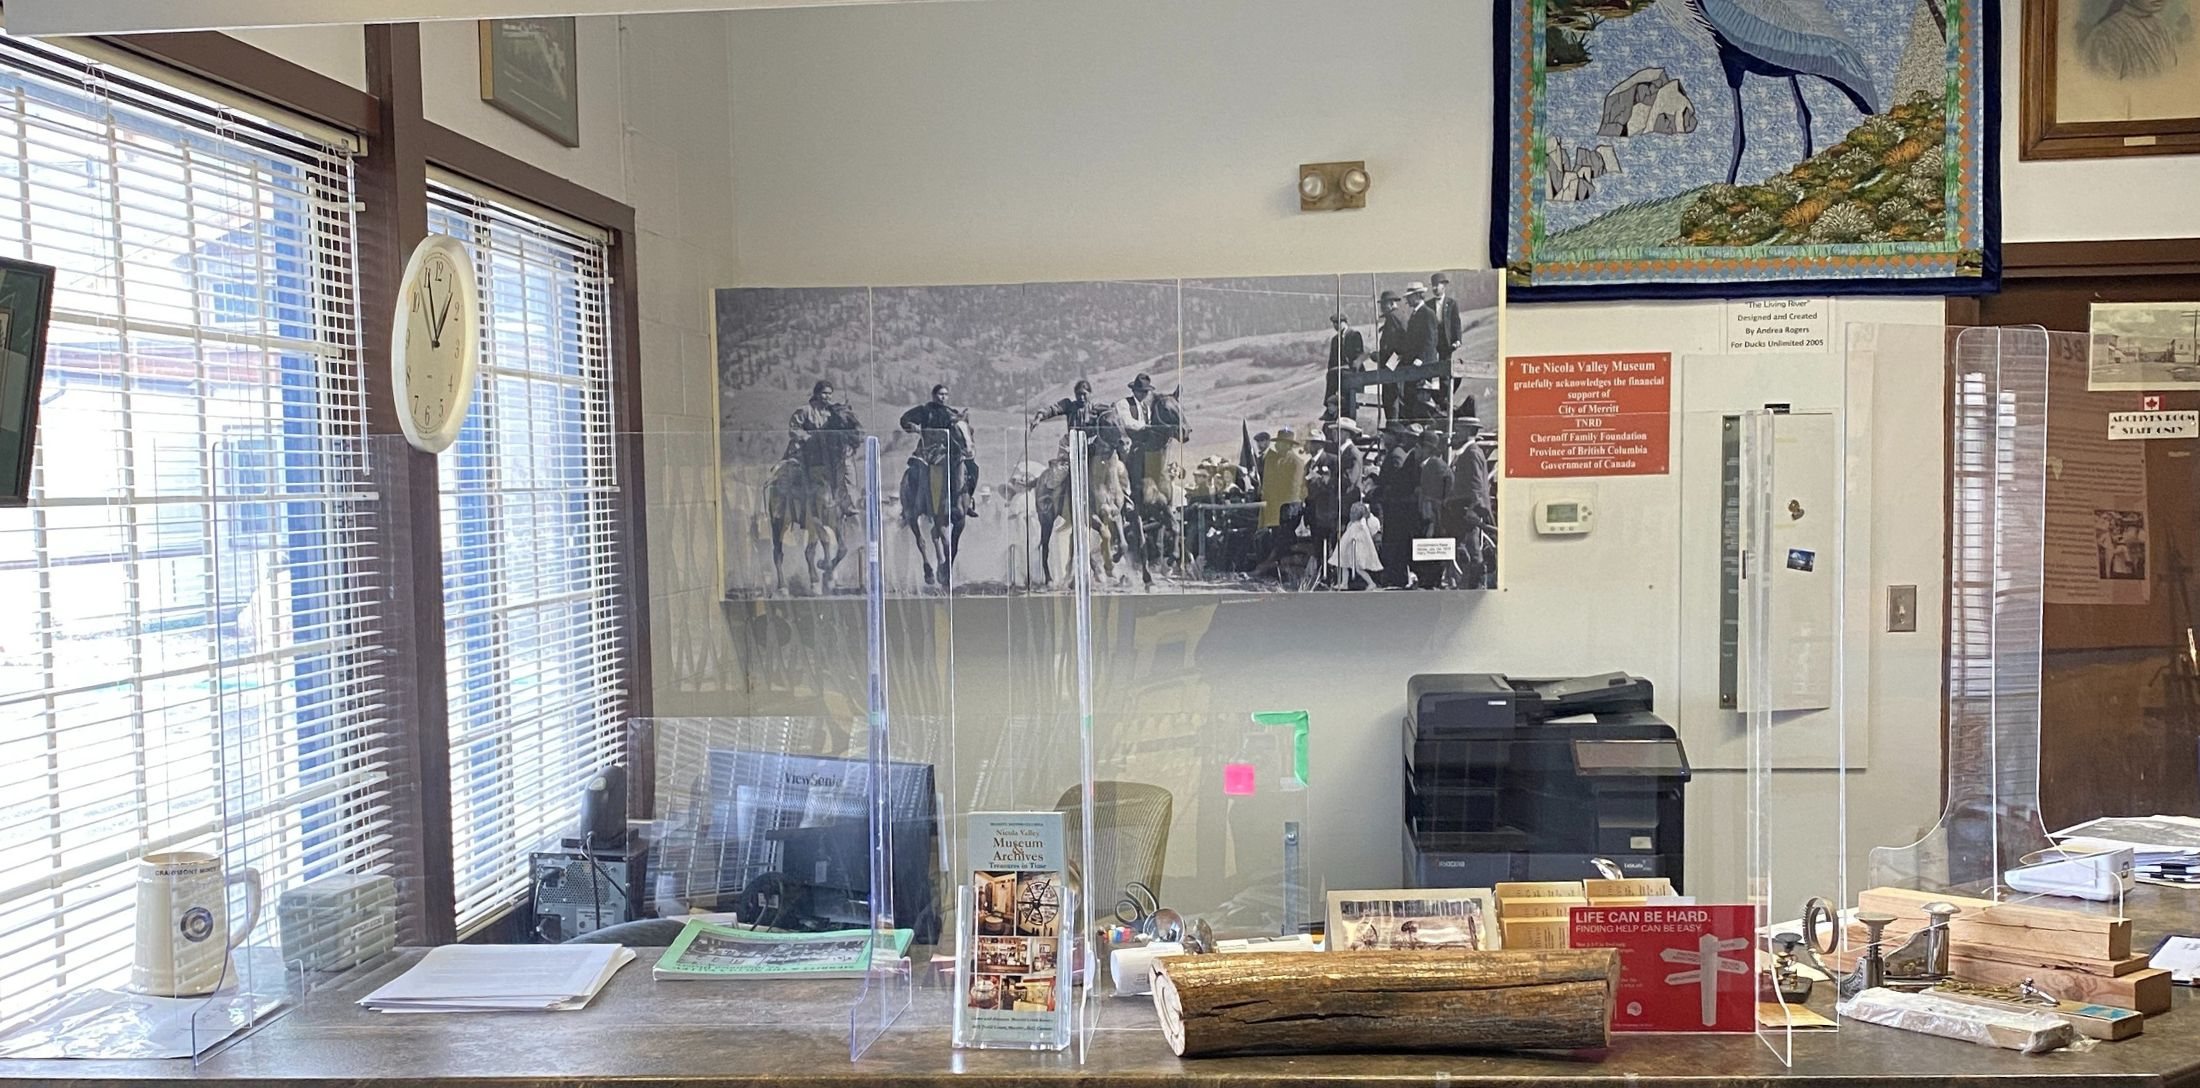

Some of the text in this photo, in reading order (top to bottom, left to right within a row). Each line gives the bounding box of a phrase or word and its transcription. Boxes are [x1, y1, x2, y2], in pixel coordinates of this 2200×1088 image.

[435, 260, 444, 282] 12
[424, 267, 431, 288] 11
[448, 273, 452, 293] 1
[412, 291, 420, 313] 10
[1764, 300, 1786, 308] Living
[454, 301, 461, 322] 2
[1737, 314, 1771, 322] Designed
[1789, 312, 1817, 320] Created
[1745, 326, 1810, 336] By Andrea Rogers
[455, 339, 460, 359] 3
[1521, 361, 1655, 374] The Nicola Valley Museum
[1514, 376, 1665, 391] gratefully acknowledges the financial
[1568, 389, 1611, 401] support of
[413, 395, 419, 415] 7
[438, 398, 444, 417] 5
[1558, 404, 1619, 416] City of Merritt
[424, 405, 431, 426] 6
[1576, 419, 1602, 428] TNRD
[1530, 432, 1647, 444] Chernoff Family Foundation
[1530, 445, 1648, 457] Province of British Columbia
[1541, 459, 1636, 470] Government of Canada
[785, 771, 843, 787] ViewSonic
[1020, 829, 1040, 839] Valley
[993, 837, 1043, 848] Museum
[993, 851, 1044, 861] Archives
[1575, 911, 1711, 923] LIFE CAN BE HARD.
[1575, 925, 1614, 933] FINDING
[1615, 925, 1639, 933] HELP
